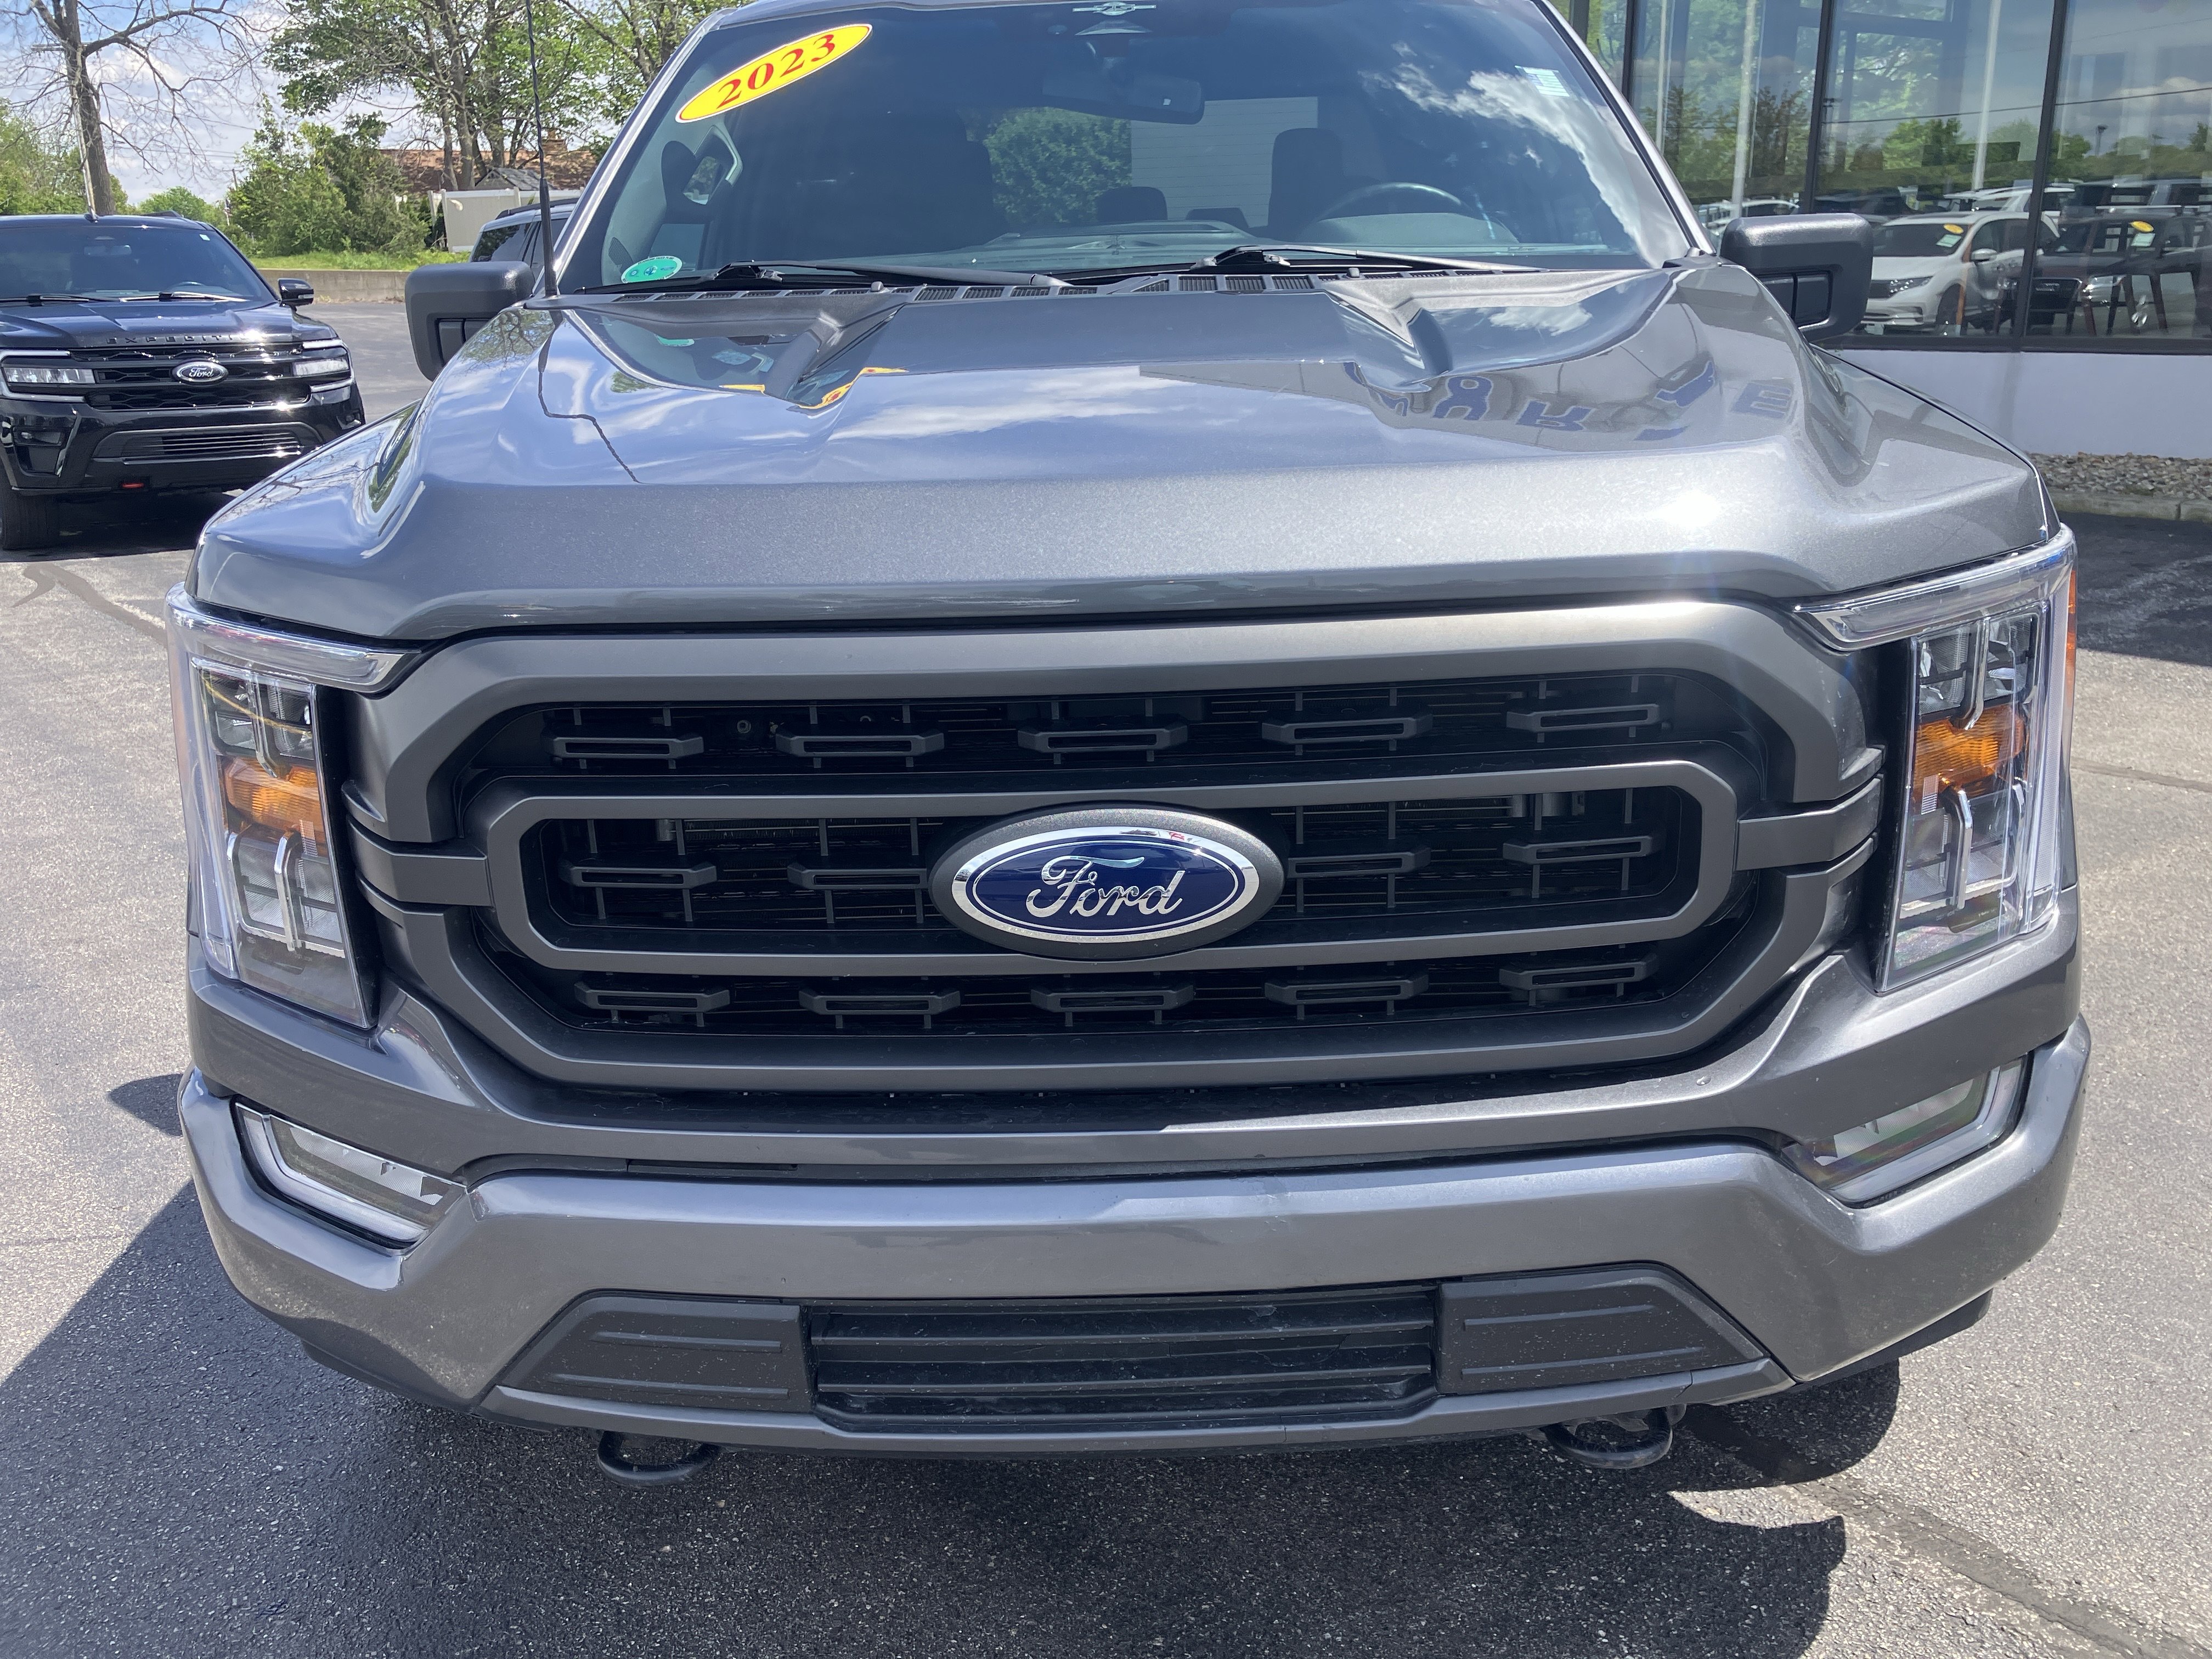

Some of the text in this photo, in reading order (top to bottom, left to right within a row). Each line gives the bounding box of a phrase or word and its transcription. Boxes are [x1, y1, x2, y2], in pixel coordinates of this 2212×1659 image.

[716, 34, 836, 109] 2023
[106, 332, 268, 345] EXPEDITI
[189, 367, 215, 377] Ford
[1026, 855, 1186, 918] Ford
